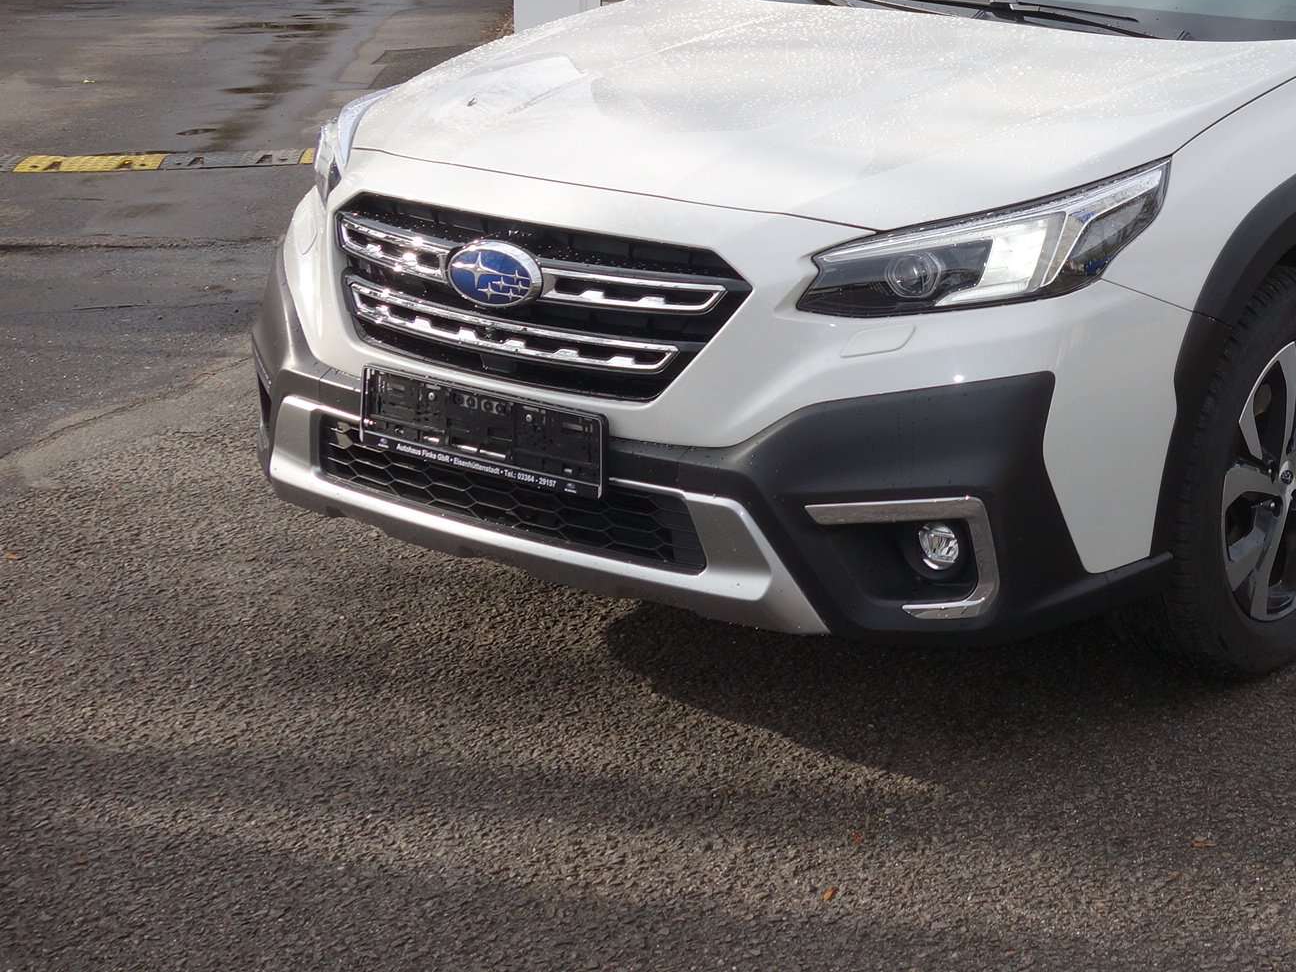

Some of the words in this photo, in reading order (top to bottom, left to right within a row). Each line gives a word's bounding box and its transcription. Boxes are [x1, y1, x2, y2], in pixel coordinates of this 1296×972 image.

[396, 443, 421, 456] Autohaus
[437, 454, 450, 463] GbR
[453, 457, 500, 476] Eisenhüttenstadt
[517, 473, 535, 483] 03364
